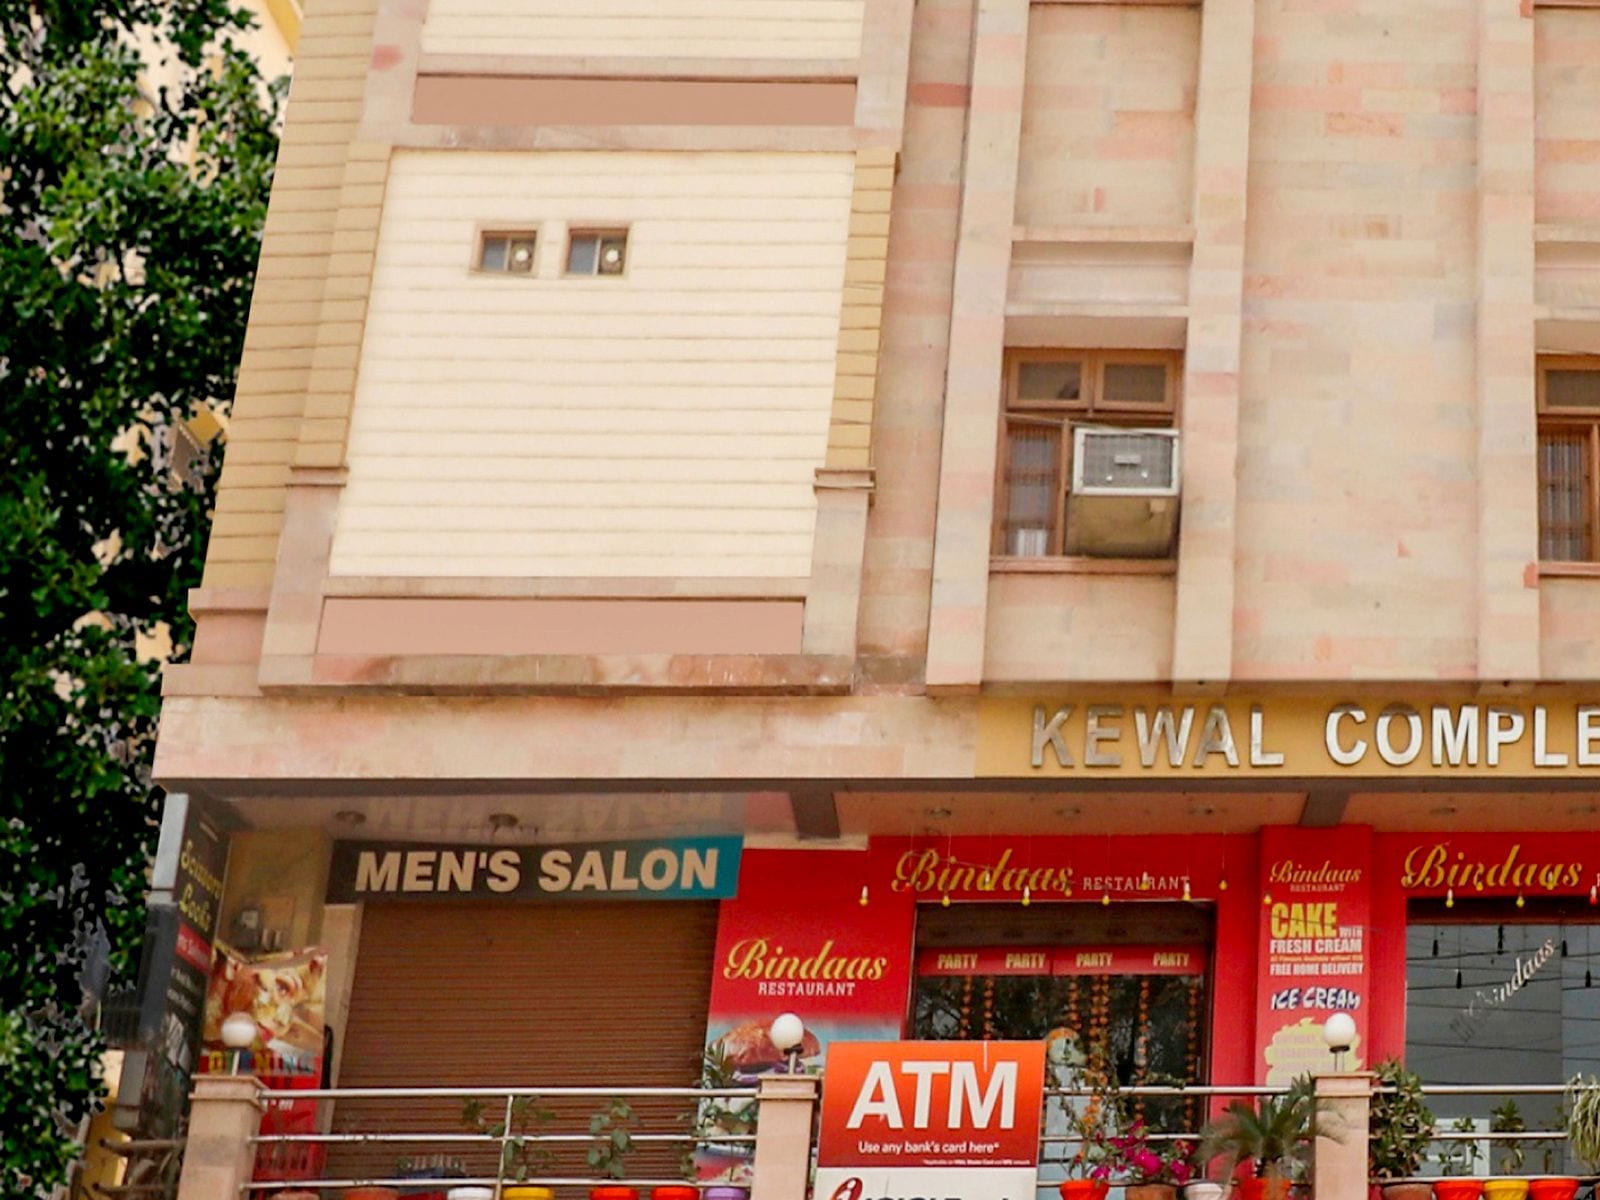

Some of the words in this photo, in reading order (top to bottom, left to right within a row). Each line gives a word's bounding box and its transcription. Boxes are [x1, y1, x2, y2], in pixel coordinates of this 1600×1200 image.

[1030, 704, 1286, 768] KEWAL
[355, 849, 521, 892] MEN'S
[538, 847, 719, 892] SALON
[891, 848, 1074, 893] Bindaas
[1269, 860, 1361, 883] Bindaas
[1400, 839, 1582, 888] Bindaas
[1271, 903, 1337, 939] CAKE
[1270, 939, 1312, 954] FRESH
[1315, 939, 1362, 953] CREAM
[723, 938, 888, 980] Bindaas
[938, 953, 978, 969] PARTY
[1005, 952, 1046, 969] PARTY
[1076, 952, 1113, 968] PARTY
[1153, 952, 1190, 967] PARTY
[1270, 963, 1291, 975] FREE
[1321, 962, 1363, 975] DELIVERY
[758, 982, 856, 996] RESTAURANT
[1271, 988, 1301, 1010] ICE
[1303, 986, 1361, 1009] CREAM
[846, 1061, 1018, 1129] ATM
[858, 1141, 881, 1153] Use
[882, 1143, 902, 1155] any
[905, 1141, 940, 1153] bank's
[942, 1141, 967, 1153] card
